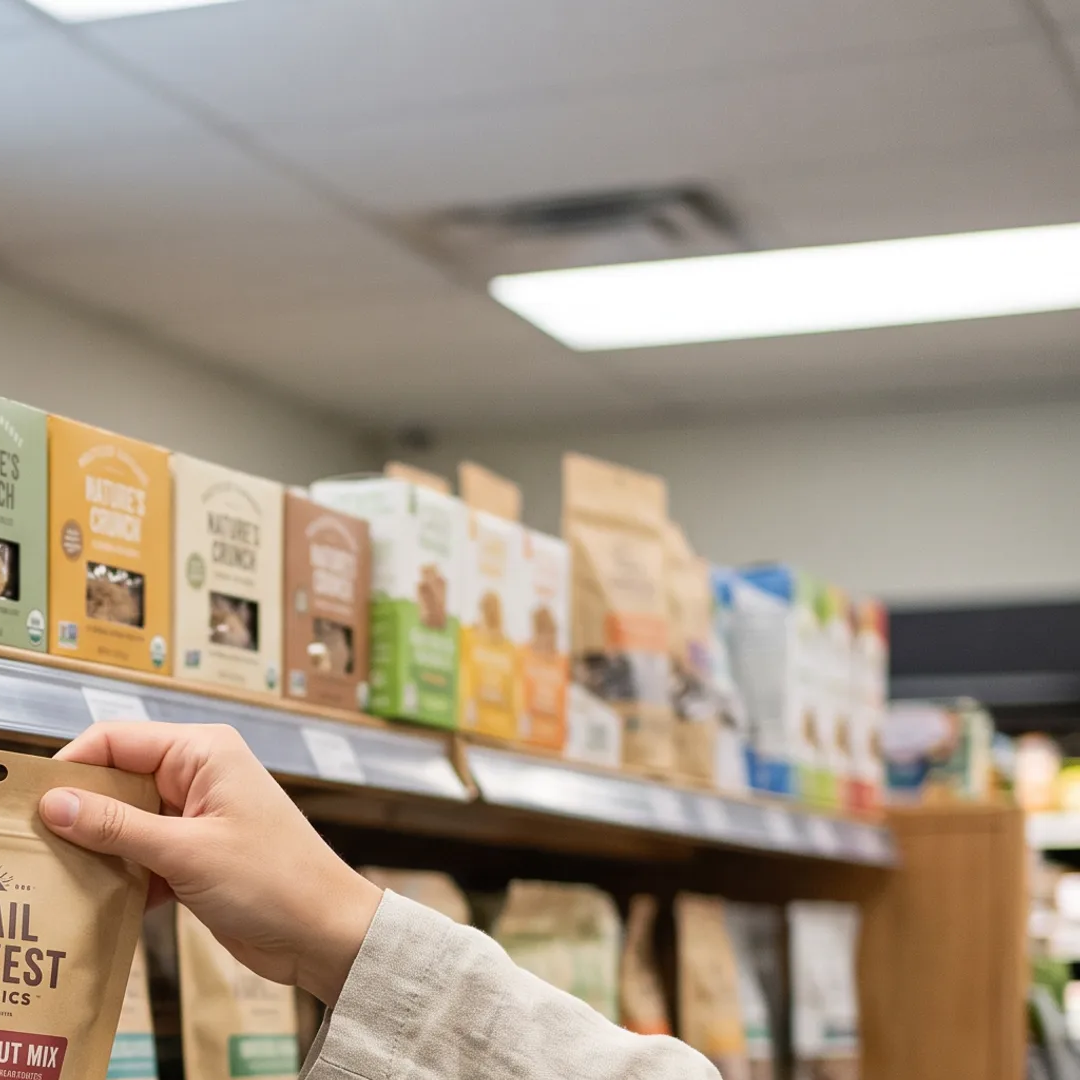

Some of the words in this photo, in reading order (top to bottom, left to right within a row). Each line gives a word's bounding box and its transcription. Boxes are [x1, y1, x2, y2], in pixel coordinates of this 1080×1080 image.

[85, 474, 146, 517] NATURE'S
[90, 505, 142, 543] CRUNCH
[26, 1044, 59, 1068] MIX
